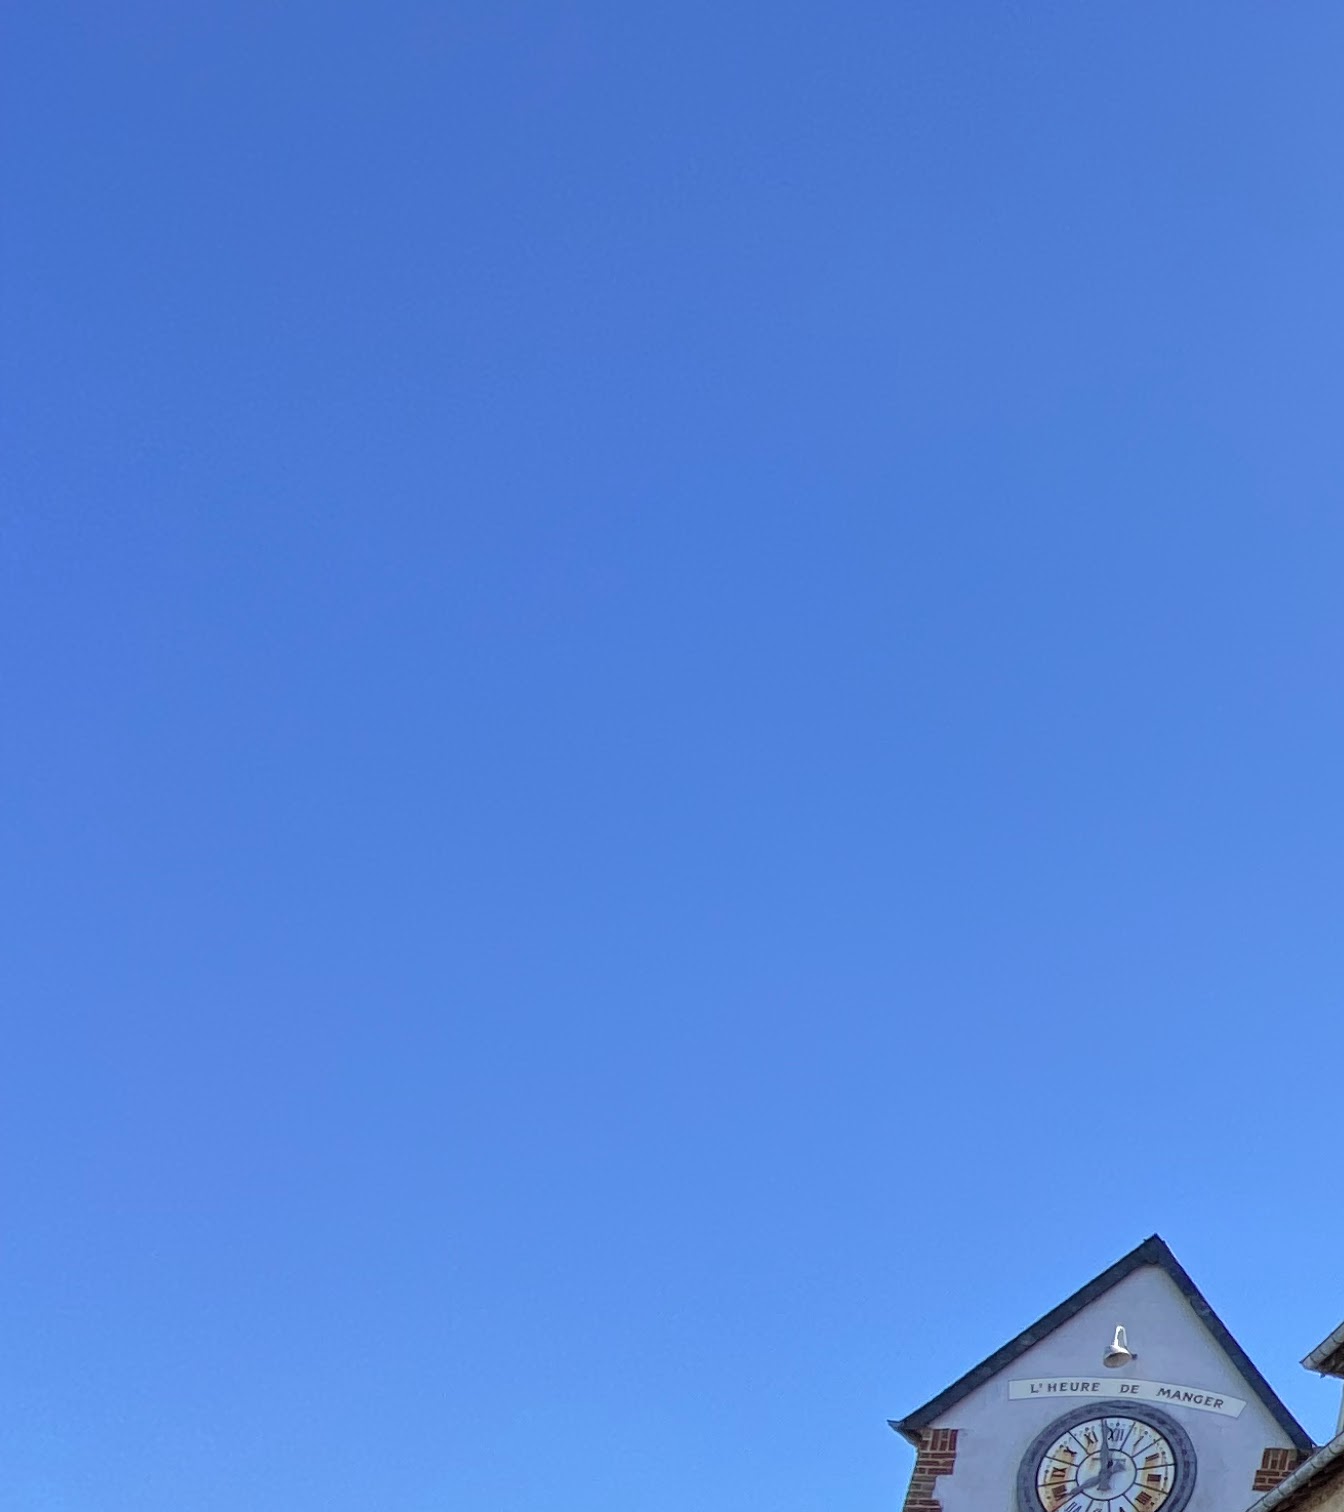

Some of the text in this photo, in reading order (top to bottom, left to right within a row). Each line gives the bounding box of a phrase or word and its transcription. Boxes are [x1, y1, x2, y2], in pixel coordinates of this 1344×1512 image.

[1030, 1382, 1224, 1410] L'HEURE DE MANGER
